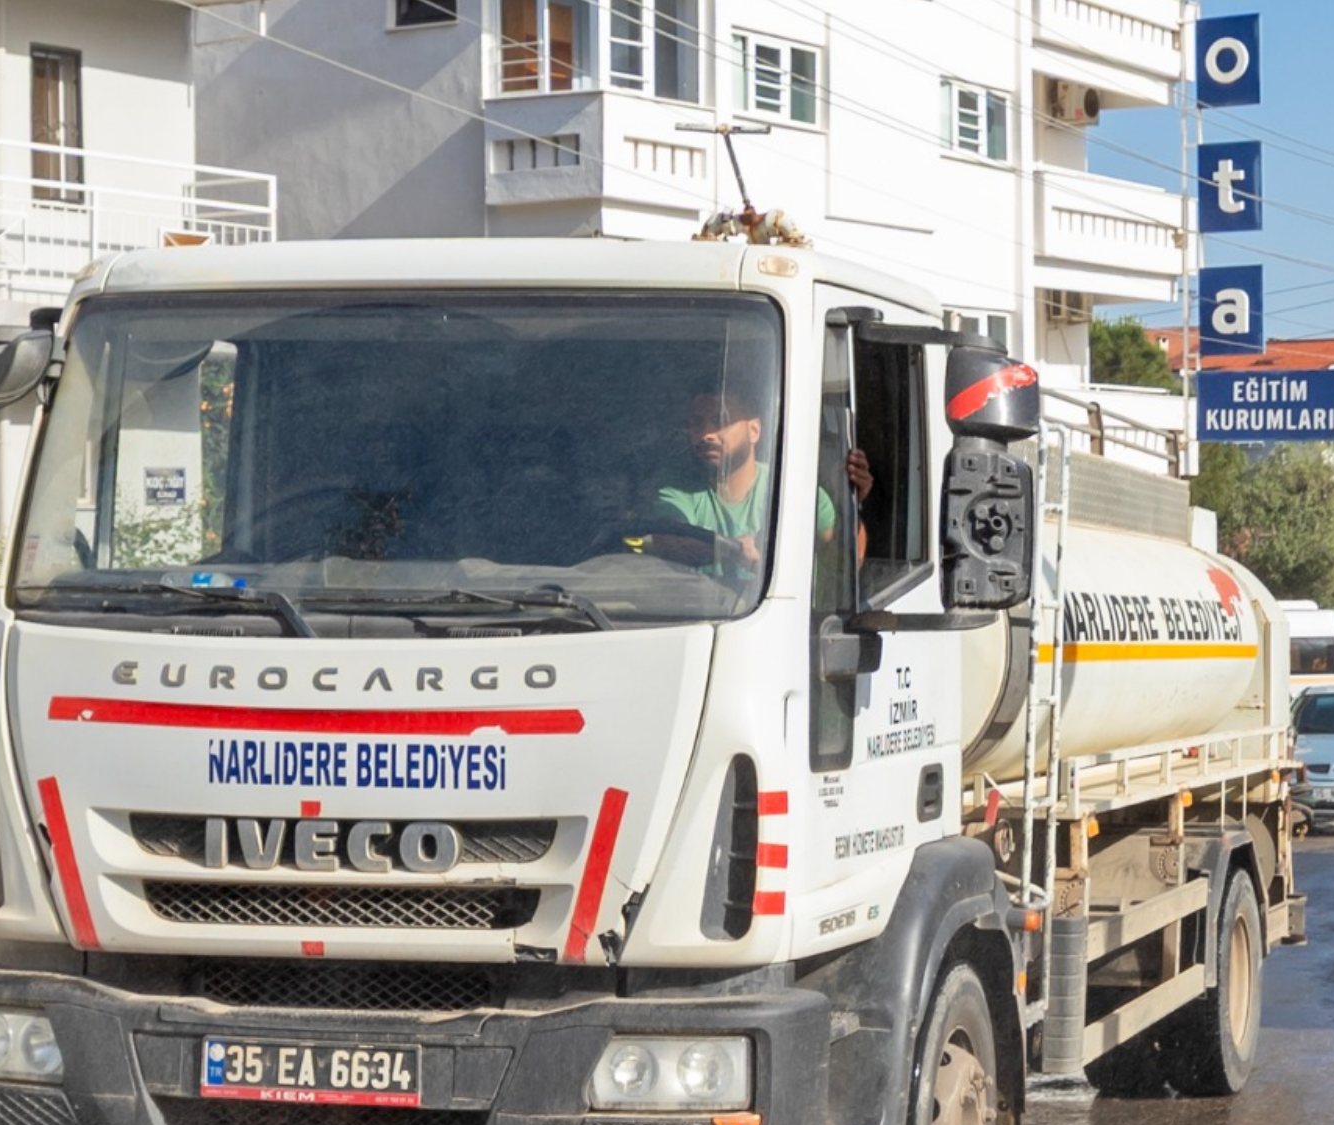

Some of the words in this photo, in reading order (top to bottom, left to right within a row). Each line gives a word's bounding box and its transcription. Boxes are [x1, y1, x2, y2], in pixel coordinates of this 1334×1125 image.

[1233, 376, 1307, 402] EĞİTİM
[1205, 407, 1334, 431] KURUMLARI
[1064, 592, 1158, 642] NARLIDERE
[112, 661, 557, 692] EUROCARGO
[889, 698, 917, 725] İZMİR
[209, 740, 347, 786] NARLIDERE
[205, 818, 465, 872] IVECO
[209, 1066, 223, 1077] TR
[226, 1045, 263, 1083] 35
[278, 1047, 315, 1086] EA
[330, 1050, 411, 1090] 6634
[260, 1090, 315, 1101] KIEM
